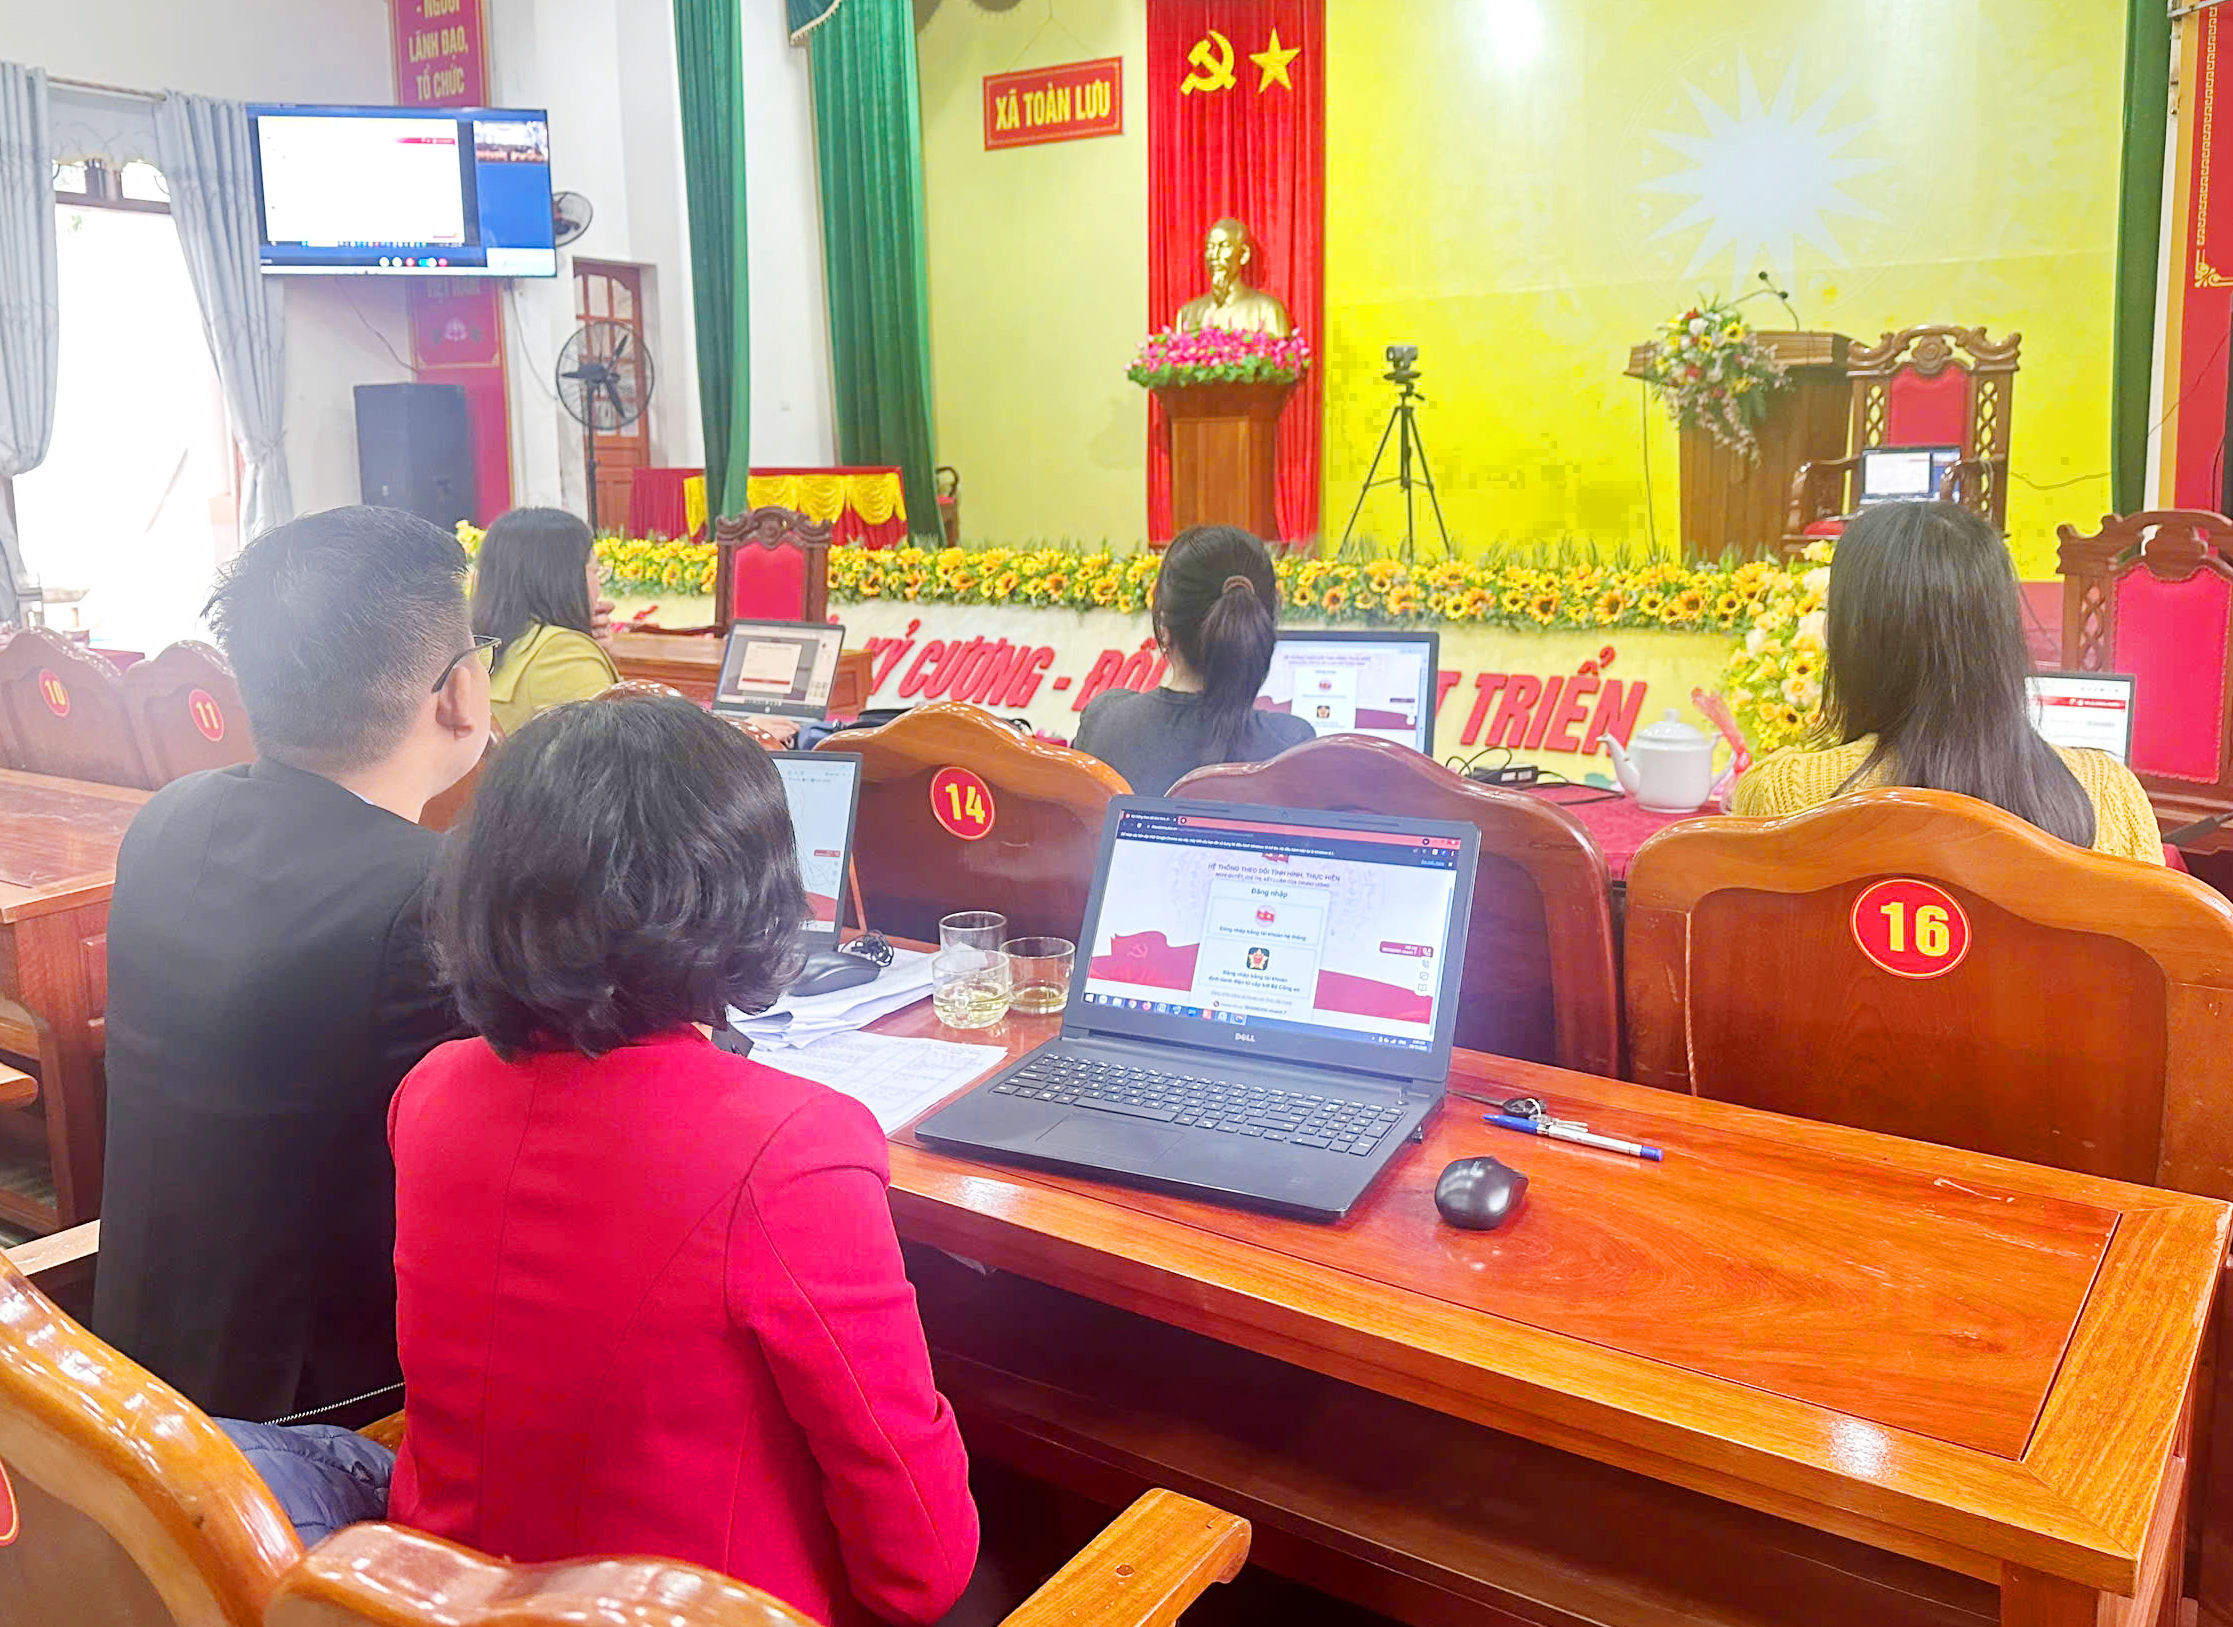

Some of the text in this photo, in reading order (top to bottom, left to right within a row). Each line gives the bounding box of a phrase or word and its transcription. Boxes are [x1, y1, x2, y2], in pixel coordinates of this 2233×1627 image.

[408, 31, 439, 62] LÃNH
[416, 63, 465, 101] TỔ CHỨC
[995, 78, 1111, 131] XÃ TOÀN LƯU
[44, 680, 67, 705] 10
[899, 635, 1056, 708] CƯƠNG
[1460, 645, 1648, 758] TRIỂN
[196, 701, 219, 729] 11
[945, 782, 986, 825] 14
[1251, 887, 1269, 897] Đăng
[1880, 901, 1950, 957] 16
[1235, 1032, 1256, 1042] DELL
